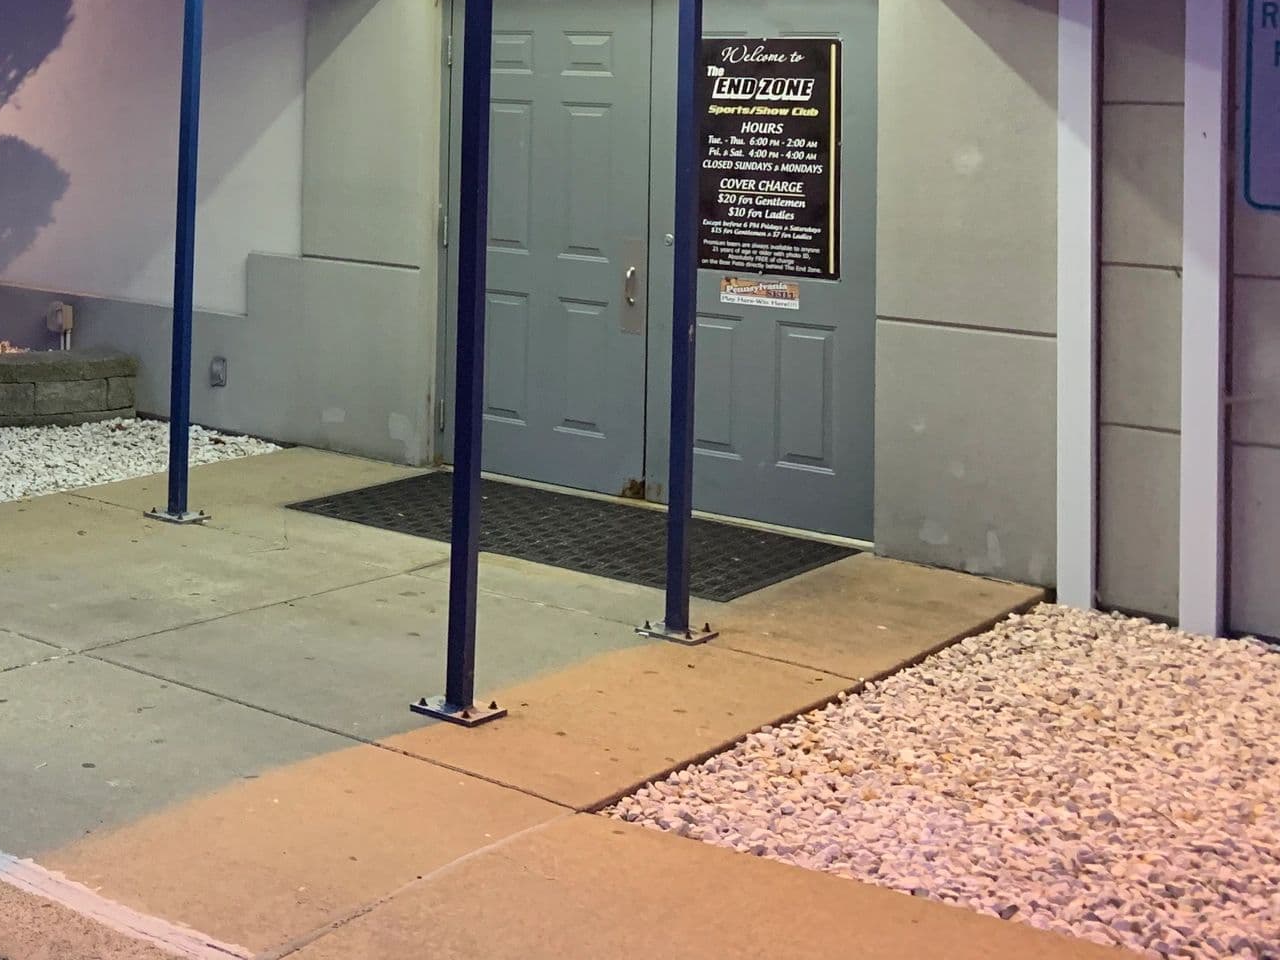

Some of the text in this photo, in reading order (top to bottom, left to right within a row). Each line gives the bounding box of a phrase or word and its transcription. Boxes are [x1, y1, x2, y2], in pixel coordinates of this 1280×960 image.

[721, 45, 805, 63] Welcome to
[707, 65, 725, 77] The
[712, 77, 816, 101] END ZONE
[708, 104, 819, 117] Sports/Show Club
[741, 121, 784, 134] HOURS
[708, 135, 723, 144] Tue.
[730, 136, 746, 145] Thu.
[749, 137, 768, 146] 6:00
[786, 138, 806, 147] 2:00
[709, 147, 721, 156] Fri.
[729, 148, 745, 157] Sat.
[749, 149, 768, 158] 4:00
[785, 150, 805, 160] 4:00
[702, 159, 733, 169] CLOSED
[734, 161, 774, 172] SUNDAYS
[780, 163, 823, 174] MONDAYS
[720, 178, 804, 193] COVER CHARGE
[718, 194, 806, 208] $20 for Gentlemen
[728, 207, 795, 220] $10 for Ladies
[726, 283, 787, 294] Pennsylvania
